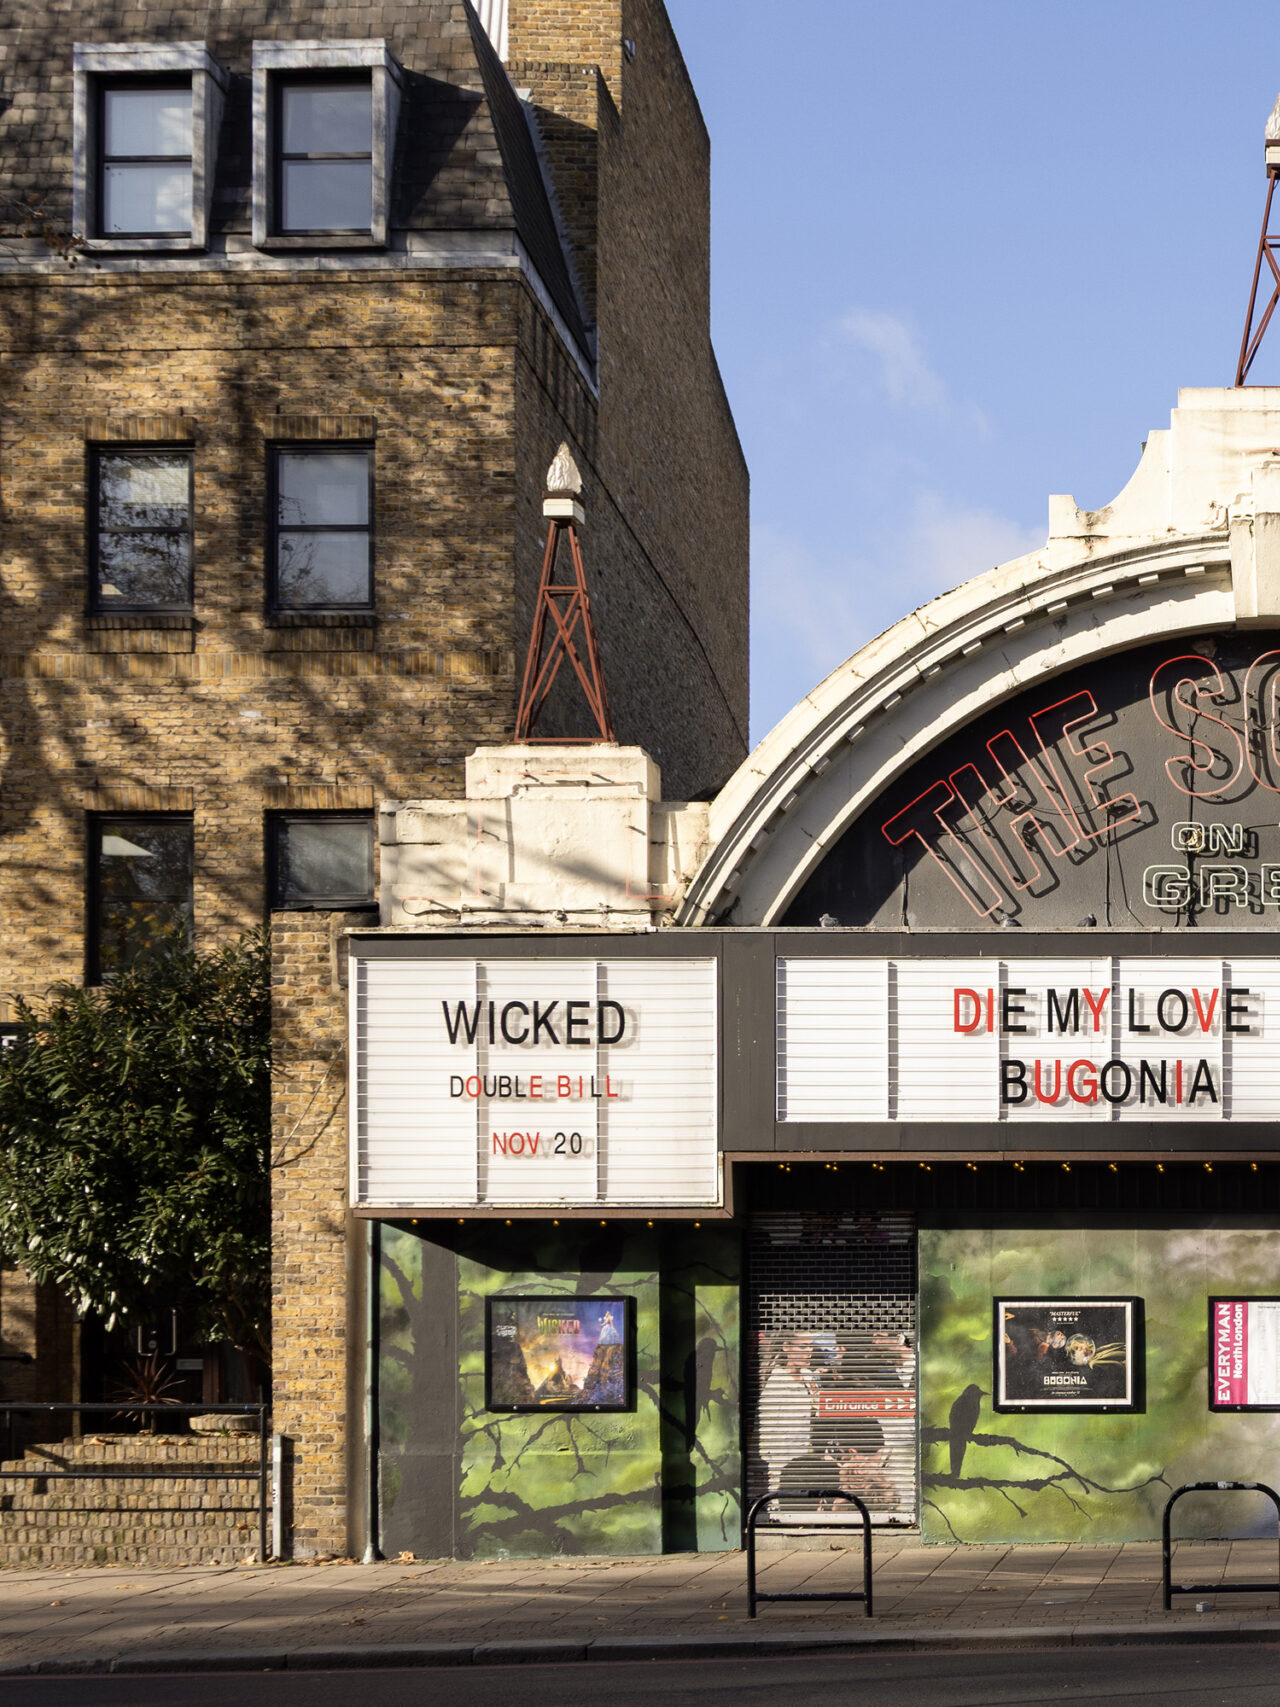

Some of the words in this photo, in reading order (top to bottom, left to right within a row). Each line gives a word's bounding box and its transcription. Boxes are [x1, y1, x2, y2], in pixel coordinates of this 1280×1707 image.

[881, 690, 1141, 917] THE
[1172, 821, 1243, 852] ON
[442, 1000, 626, 1045] WICKED
[953, 987, 1027, 1033] DIE
[1047, 987, 1111, 1033] MY
[1129, 987, 1251, 1033] LOVE
[450, 1075, 543, 1098] DOUBLE
[557, 1075, 619, 1098] BILL
[1002, 1059, 1218, 1104] BUGONIA
[493, 1132, 540, 1155] NOV
[554, 1132, 583, 1155] 20
[537, 1316, 581, 1336] WICKED
[1233, 1304, 1243, 1346] London
[1217, 1304, 1231, 1401] EVERYMAN
[1233, 1347, 1243, 1378] North
[1043, 1375, 1088, 1385] BUGONIA
[825, 1398, 879, 1410] Entrance
